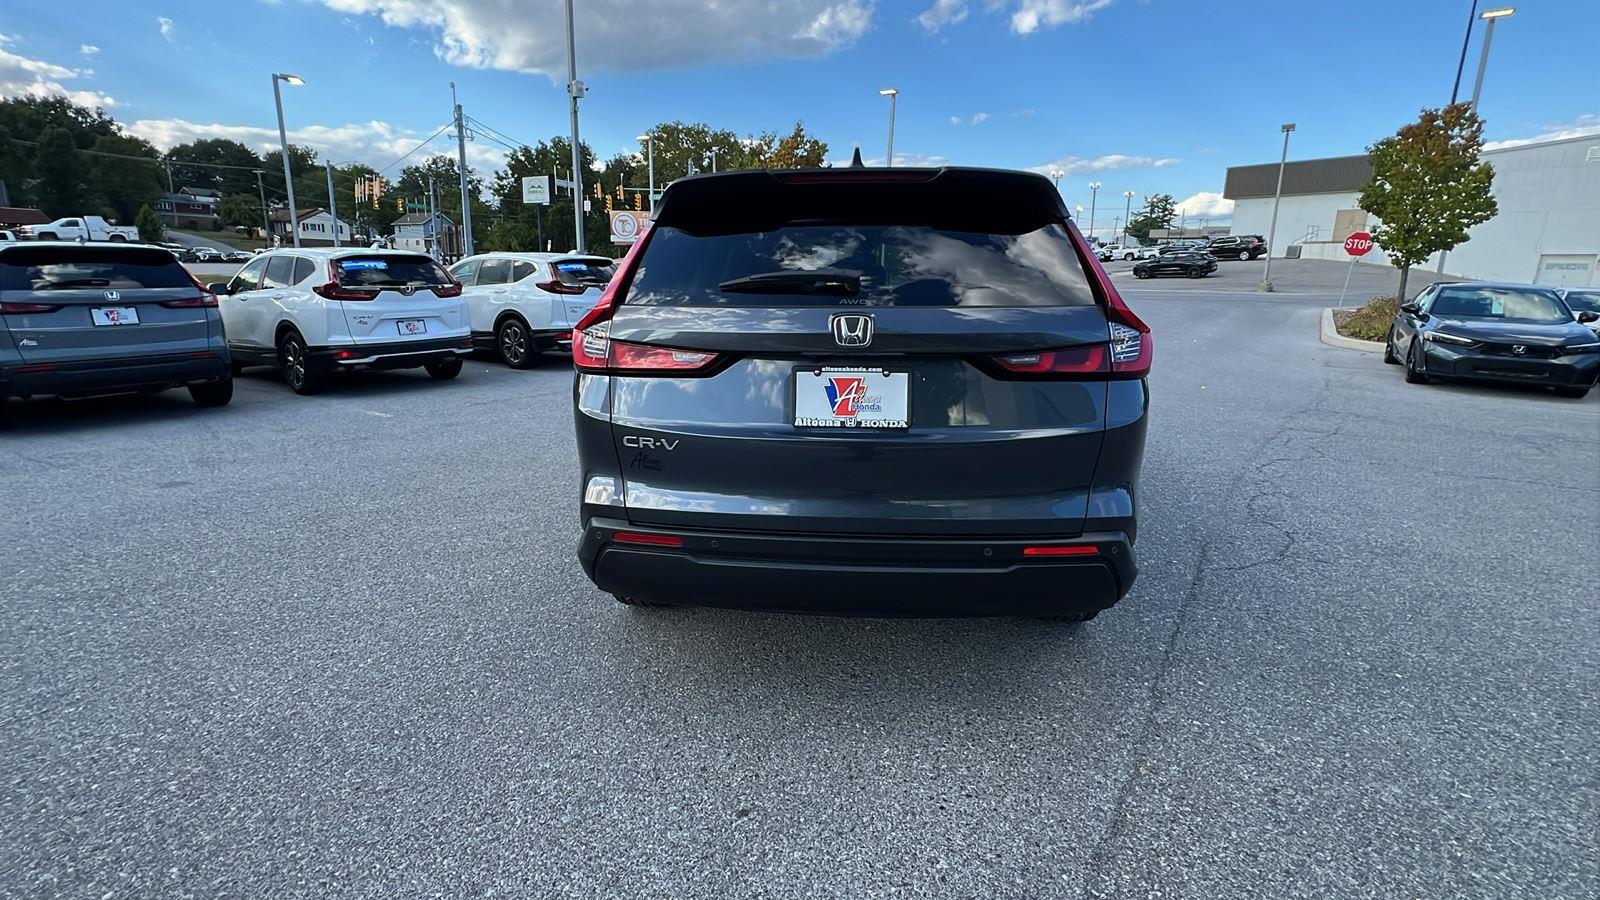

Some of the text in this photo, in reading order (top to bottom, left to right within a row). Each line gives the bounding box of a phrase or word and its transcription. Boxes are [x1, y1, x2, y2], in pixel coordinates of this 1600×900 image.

[1345, 238, 1373, 250] STOP
[794, 417, 841, 427] Altoona
[860, 419, 908, 428] HONDA
[622, 435, 679, 451] CR-V
